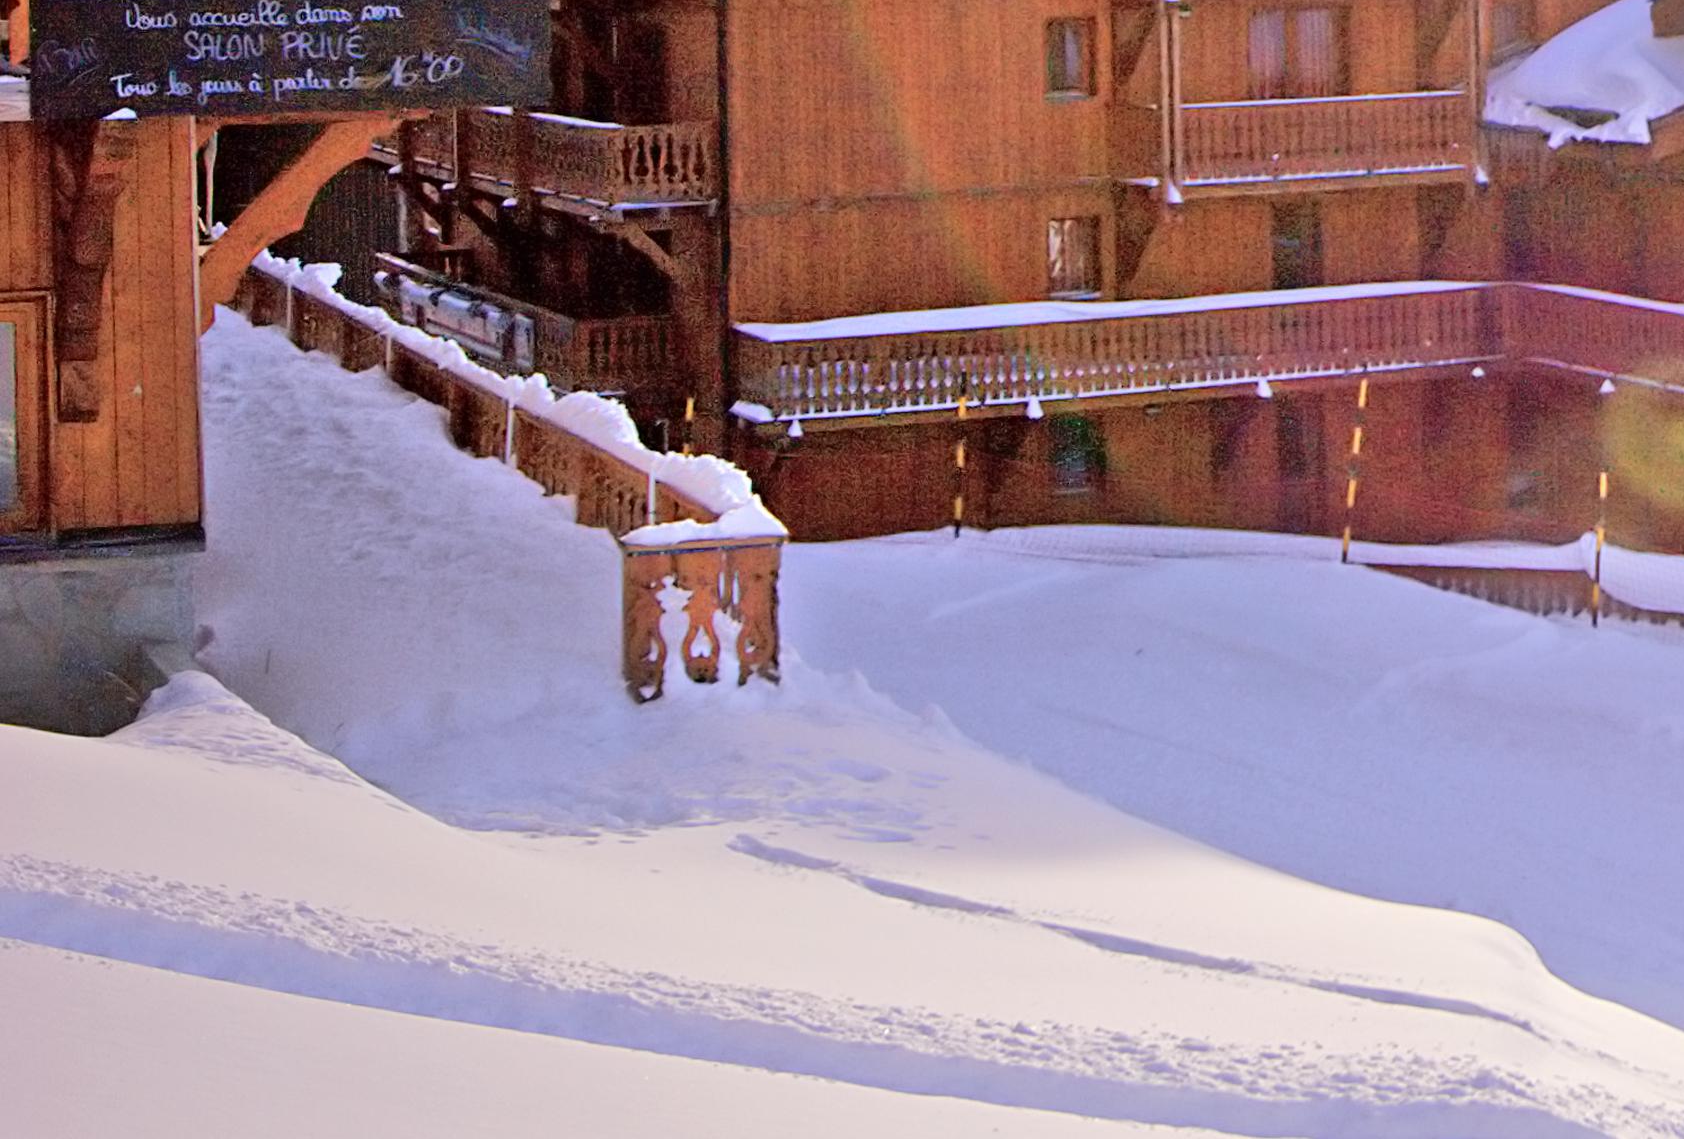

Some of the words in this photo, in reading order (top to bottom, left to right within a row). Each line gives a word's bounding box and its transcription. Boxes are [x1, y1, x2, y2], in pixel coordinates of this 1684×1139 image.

[189, 0, 288, 26] accueille
[295, 1, 352, 25] dans
[361, 5, 402, 22] son
[184, 31, 265, 61] SALON
[279, 26, 370, 61] PRIVÉ
[110, 73, 158, 98] Tous
[165, 69, 193, 96] les
[198, 80, 244, 105] jours
[248, 72, 264, 94] à
[274, 68, 333, 101] partir
